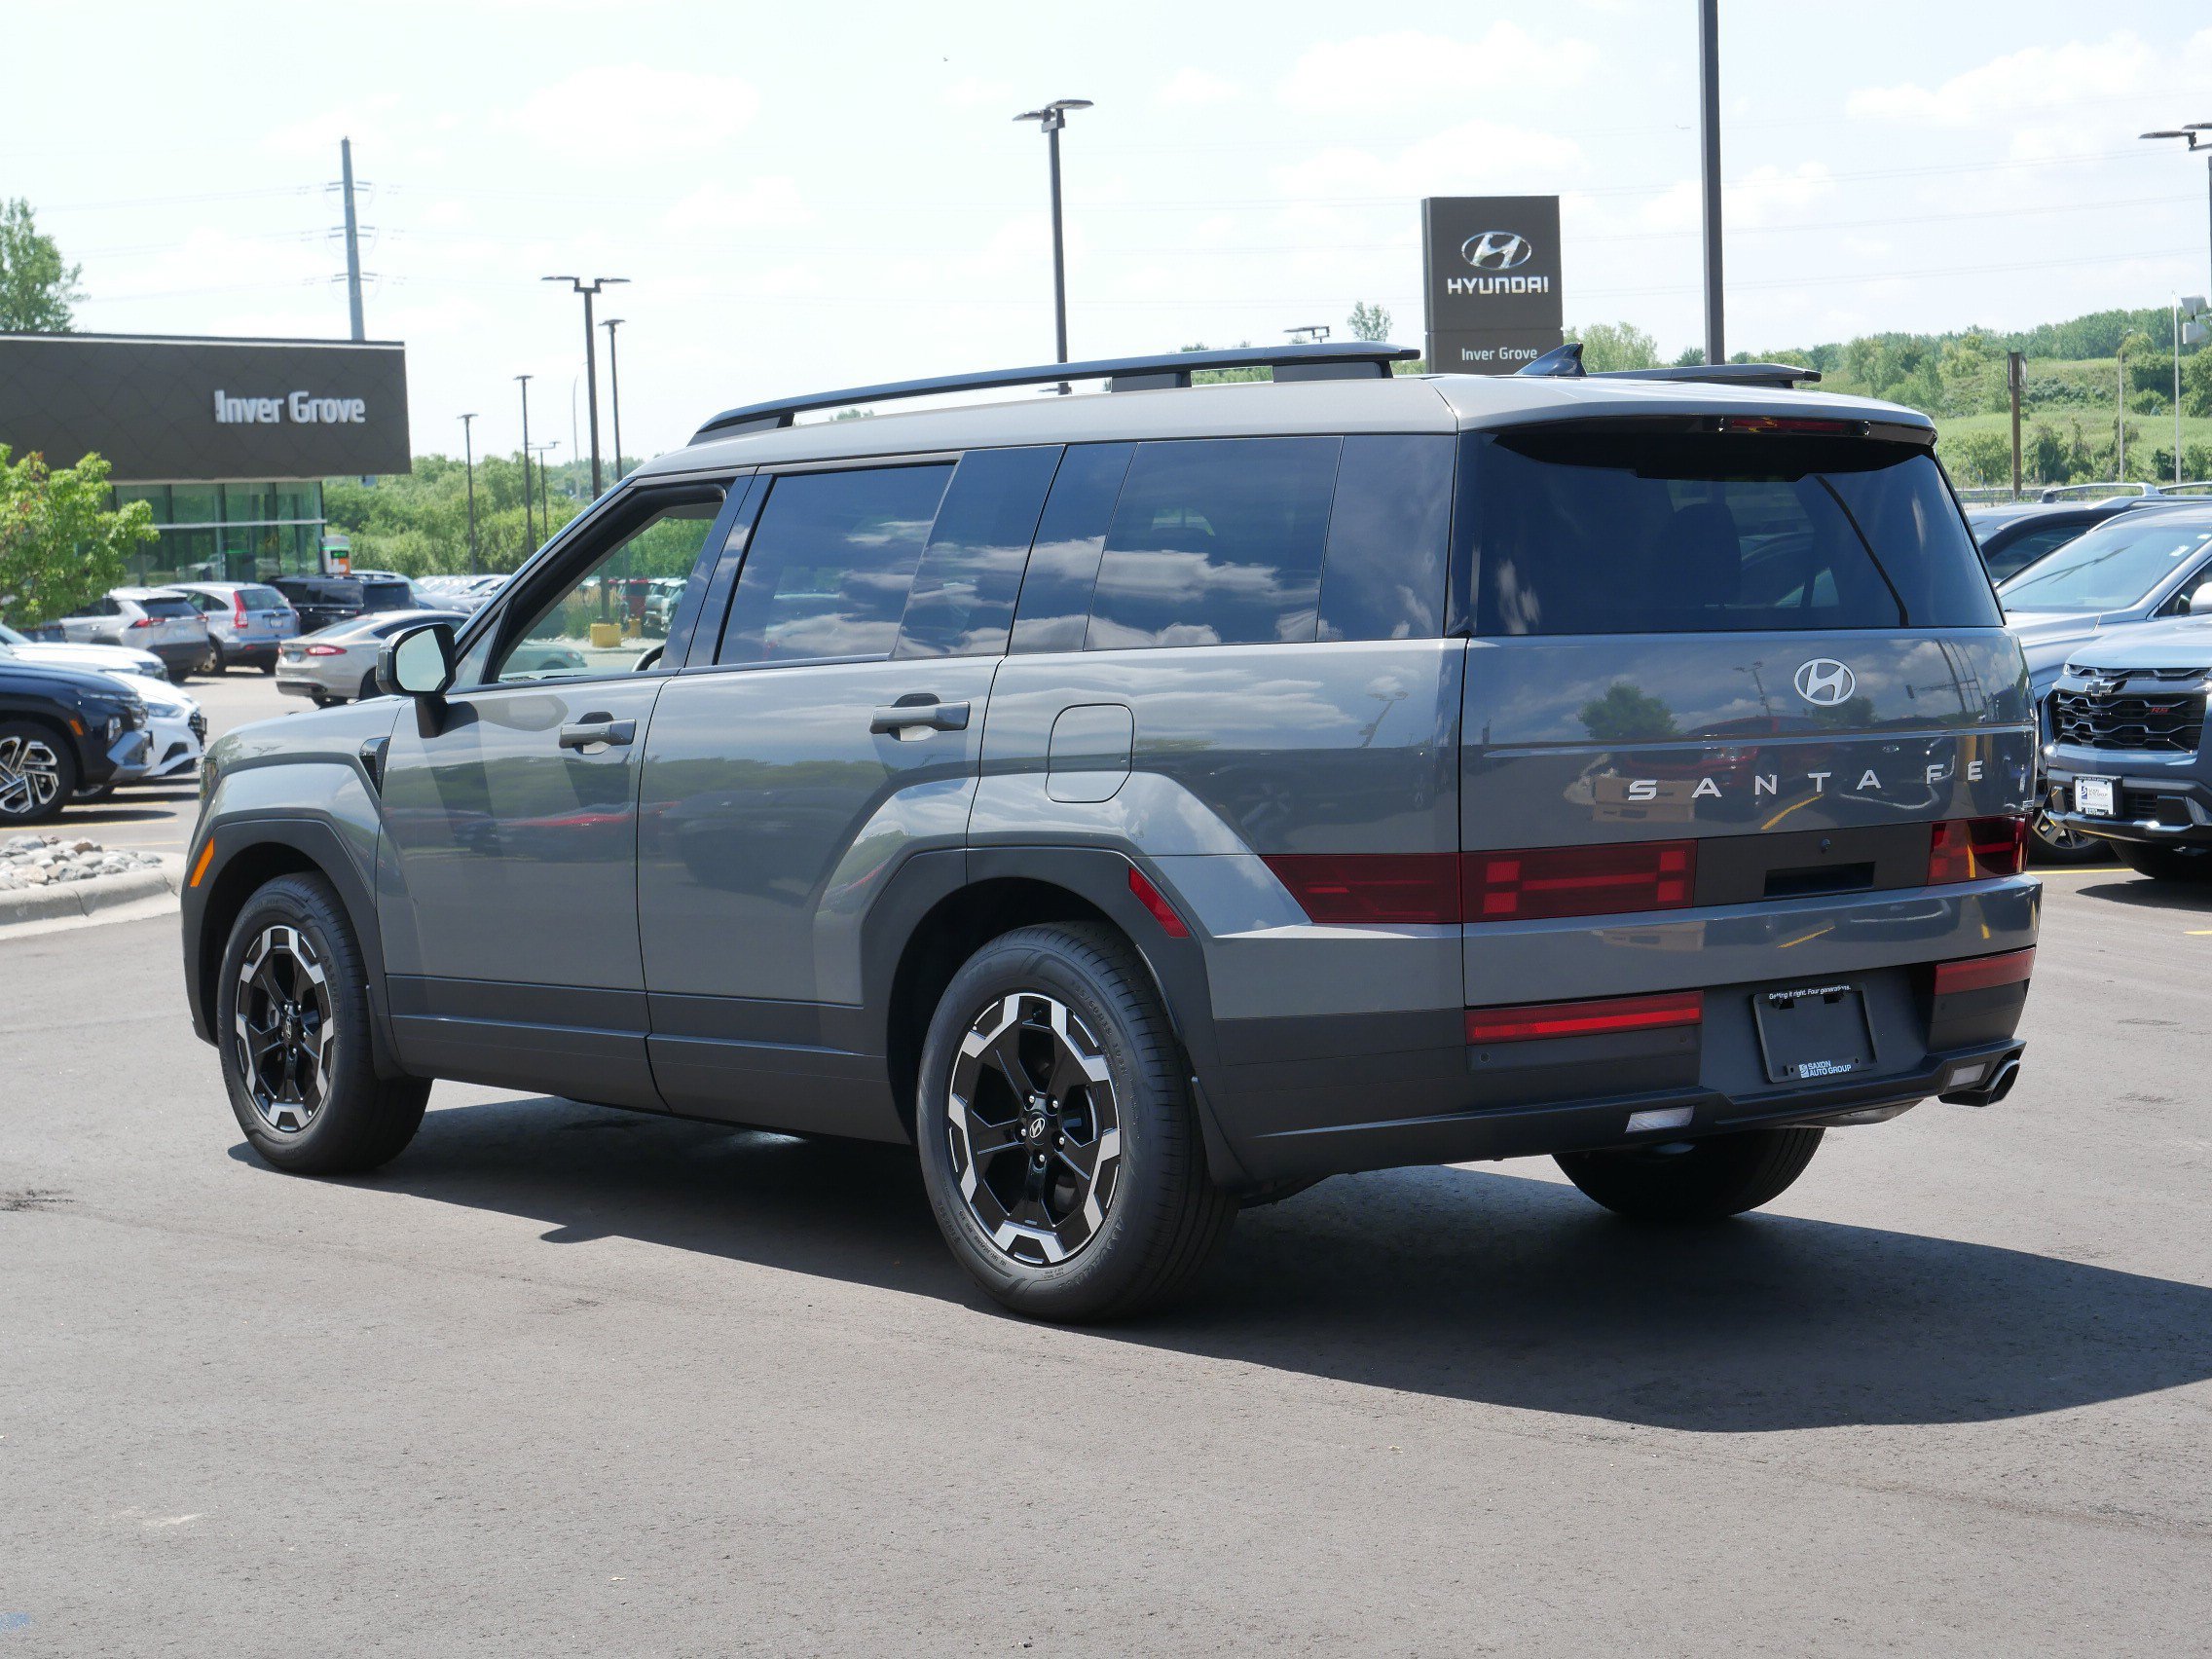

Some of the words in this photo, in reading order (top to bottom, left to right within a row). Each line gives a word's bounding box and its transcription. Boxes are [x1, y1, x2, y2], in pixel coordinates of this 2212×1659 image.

[1447, 276, 1549, 295] HYUNDAI
[1461, 348, 1495, 361] Inver
[1498, 347, 1538, 360] Grove
[214, 389, 284, 423] Inver
[288, 390, 366, 424] Grove
[1628, 769, 1883, 801] SANTA
[1926, 760, 1984, 785] FE
[1808, 1060, 1831, 1070] SAXON
[1809, 1067, 1827, 1078] AUTO
[1828, 1064, 1852, 1075] GROUP
